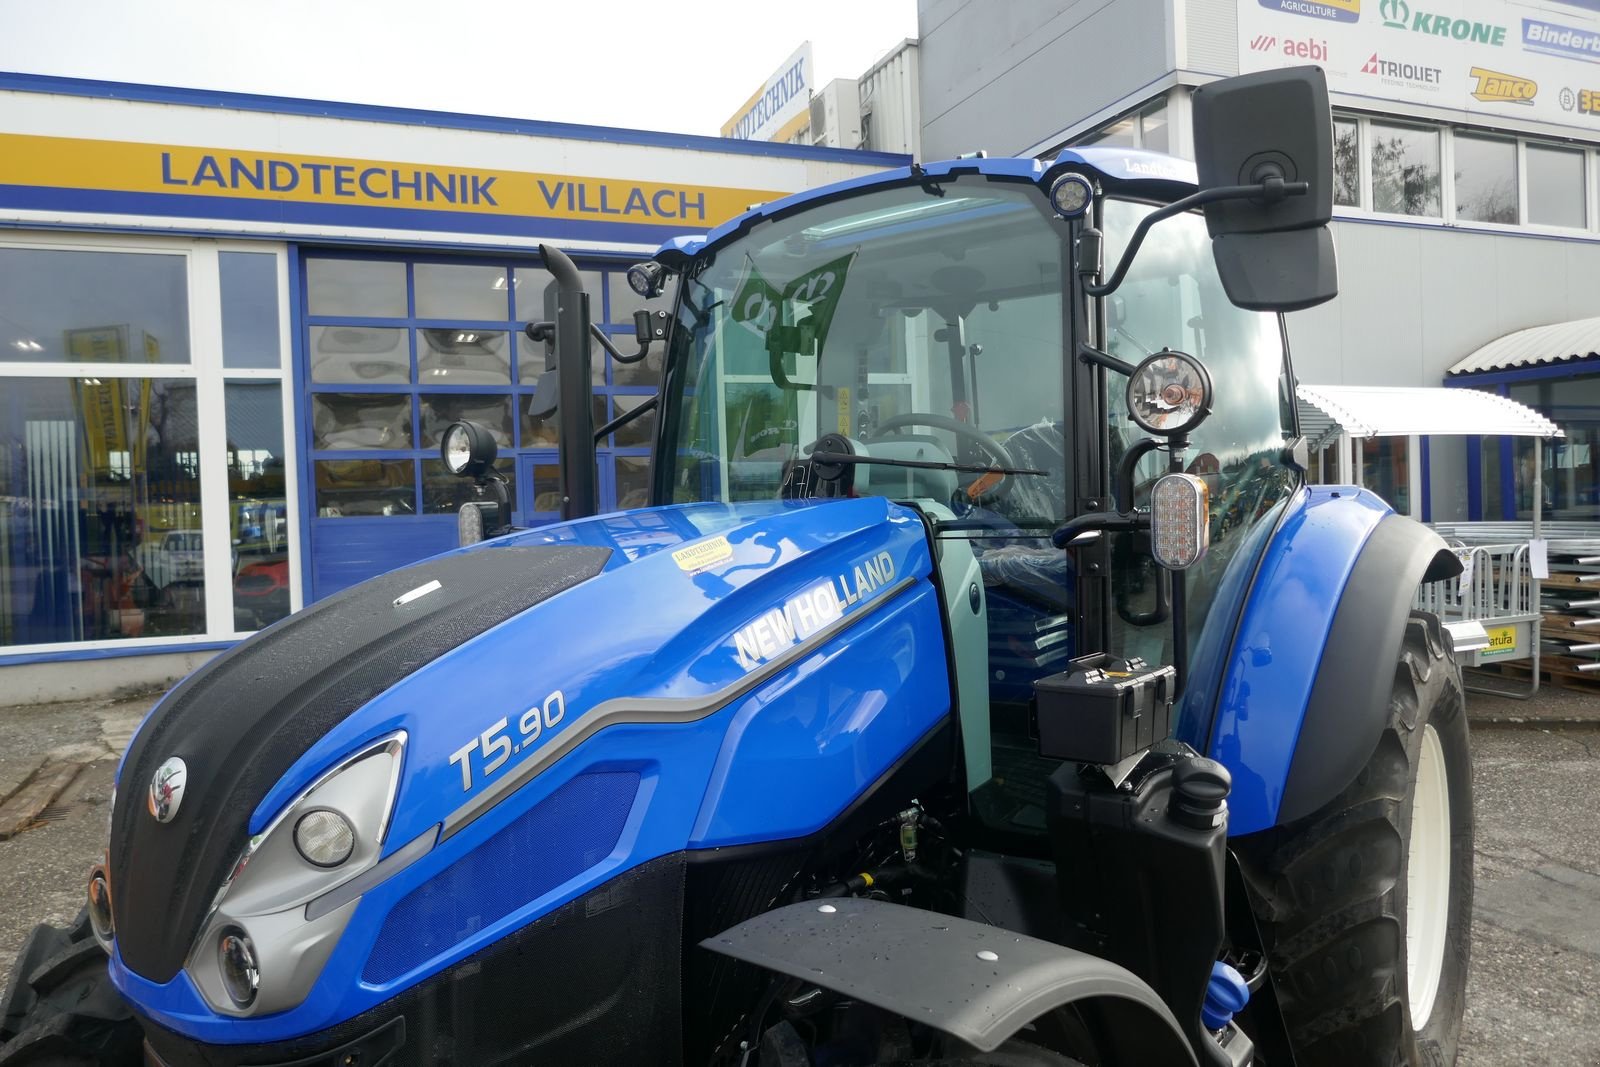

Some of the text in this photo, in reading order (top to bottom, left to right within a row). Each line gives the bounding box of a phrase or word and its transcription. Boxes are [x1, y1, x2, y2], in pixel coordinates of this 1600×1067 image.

[1280, 1, 1337, 18] AGRICULTURE
[1411, 11, 1507, 47] KRONE
[1283, 38, 1327, 61] aebi
[1378, 60, 1442, 84] TRIOLIET
[1469, 67, 1538, 101] Tanco
[724, 56, 805, 140] ANDTECHNIK
[161, 152, 706, 220] LANDTECHNIK VILLACH
[733, 550, 896, 668] NEW HOLLAND
[1487, 635, 1513, 647] atura
[449, 689, 565, 792] T5.90
